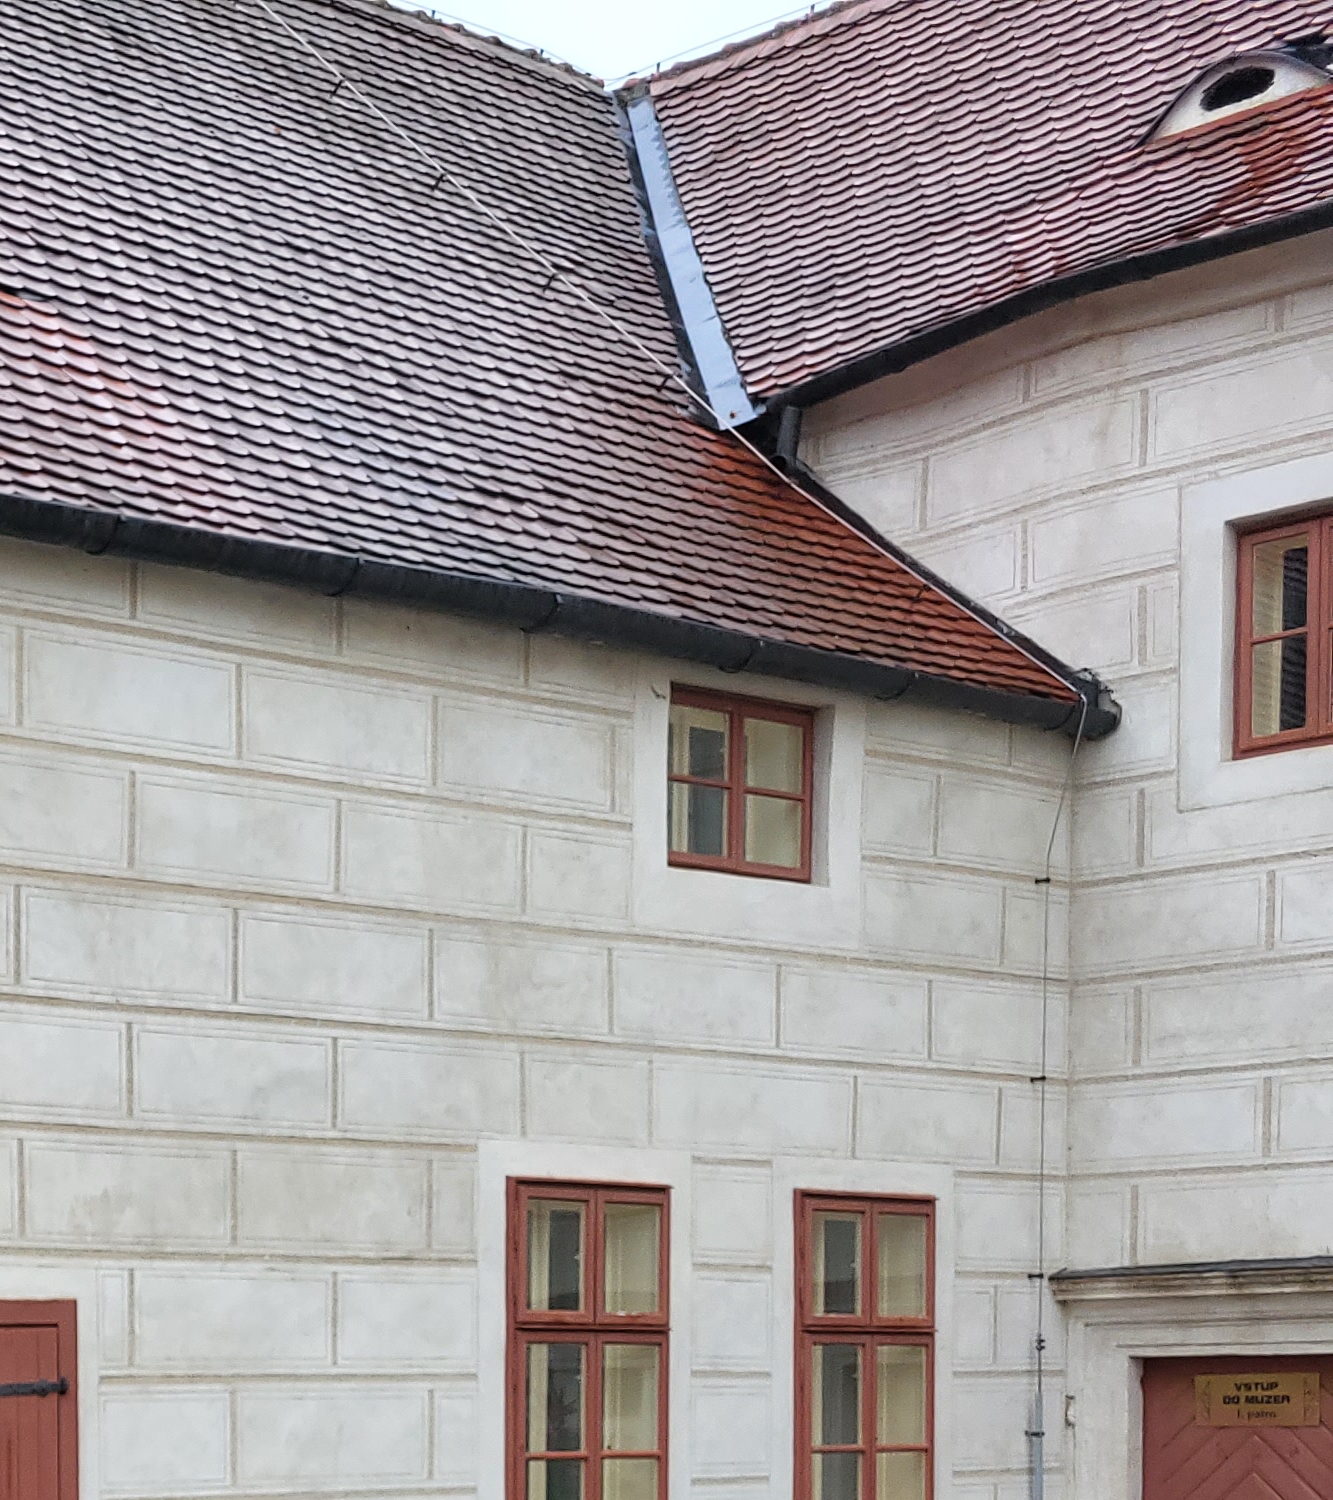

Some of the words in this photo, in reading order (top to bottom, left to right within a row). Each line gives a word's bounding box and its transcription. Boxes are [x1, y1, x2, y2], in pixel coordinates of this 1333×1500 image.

[1234, 1382, 1278, 1392] VSTUP
[1222, 1395, 1240, 1405] DO
[1244, 1395, 1290, 1404] MUZEA
